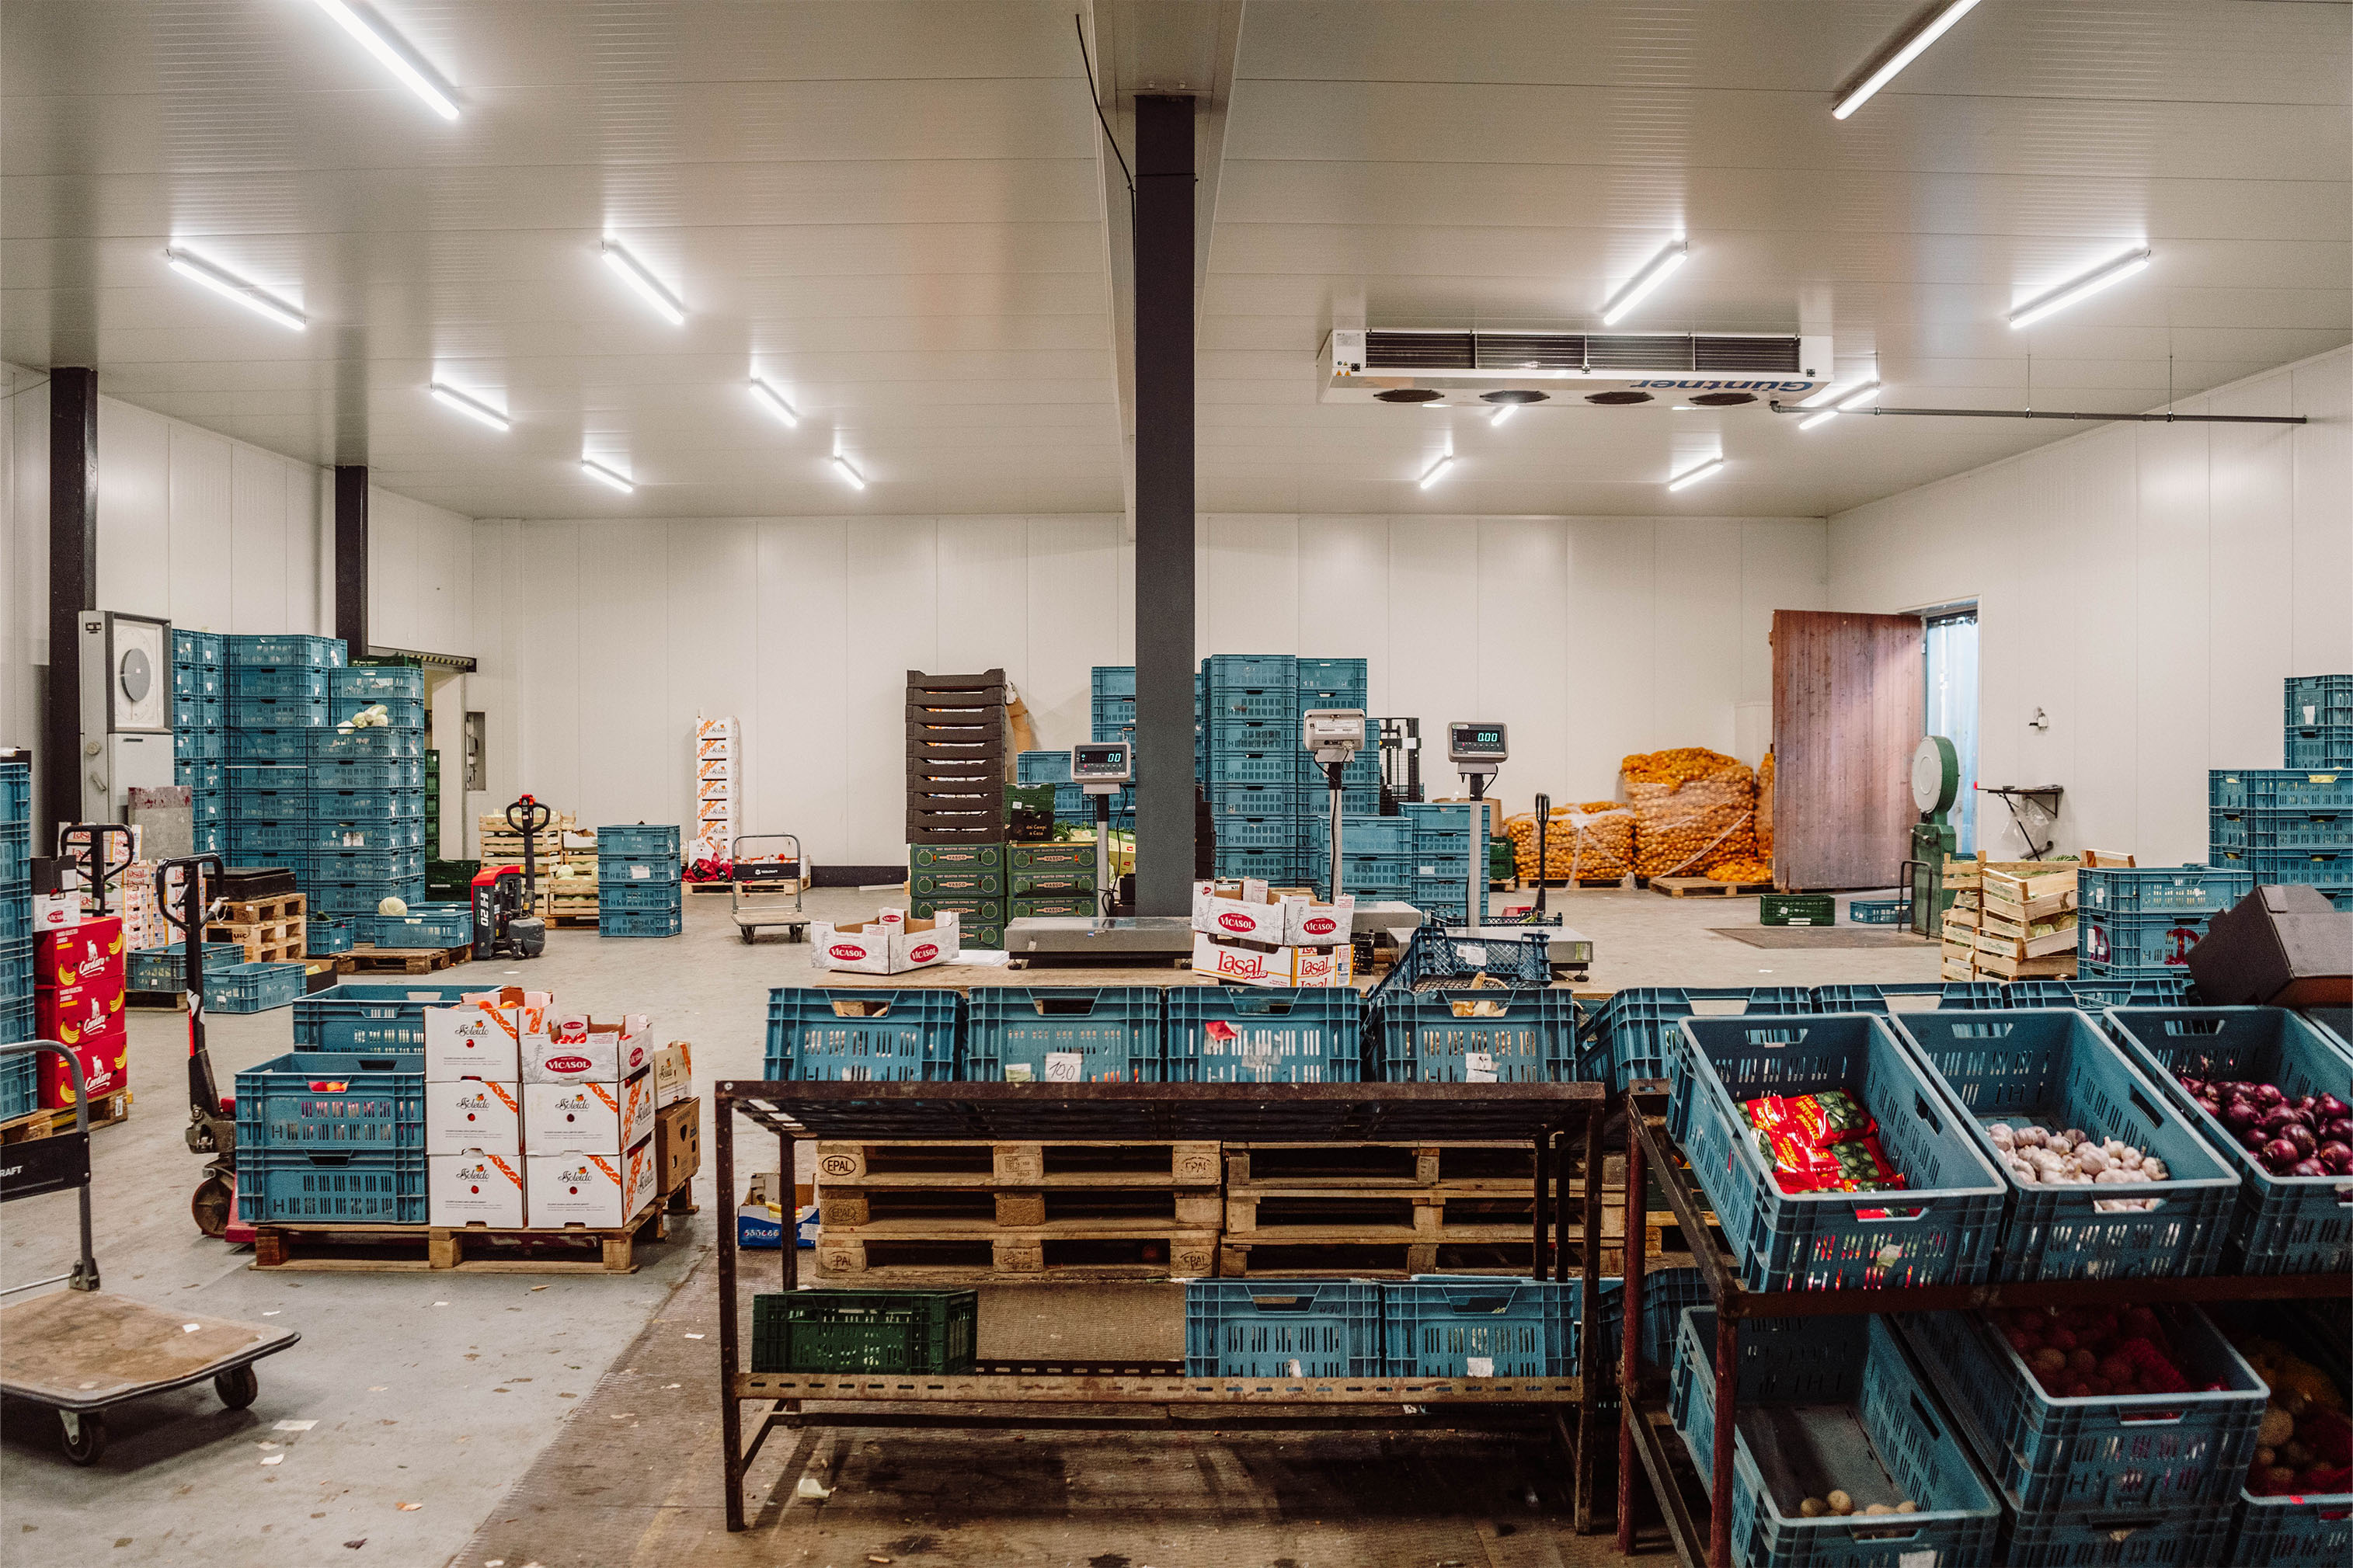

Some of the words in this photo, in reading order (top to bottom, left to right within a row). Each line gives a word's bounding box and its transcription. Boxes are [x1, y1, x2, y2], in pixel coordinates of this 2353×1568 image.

[1630, 380, 1814, 392] Güntner
[1220, 916, 1255, 930] VICASOL
[1305, 923, 1335, 932] VICASOL
[830, 947, 865, 958] VICASOL
[911, 947, 938, 960] VICASOL
[1217, 950, 1263, 975] Lasal
[1300, 957, 1328, 975] Lasal
[1244, 970, 1269, 979] PLUS
[548, 1061, 590, 1069] VICASOL
[827, 1159, 851, 1172] EPAL
[832, 1208, 853, 1218] EPAL
